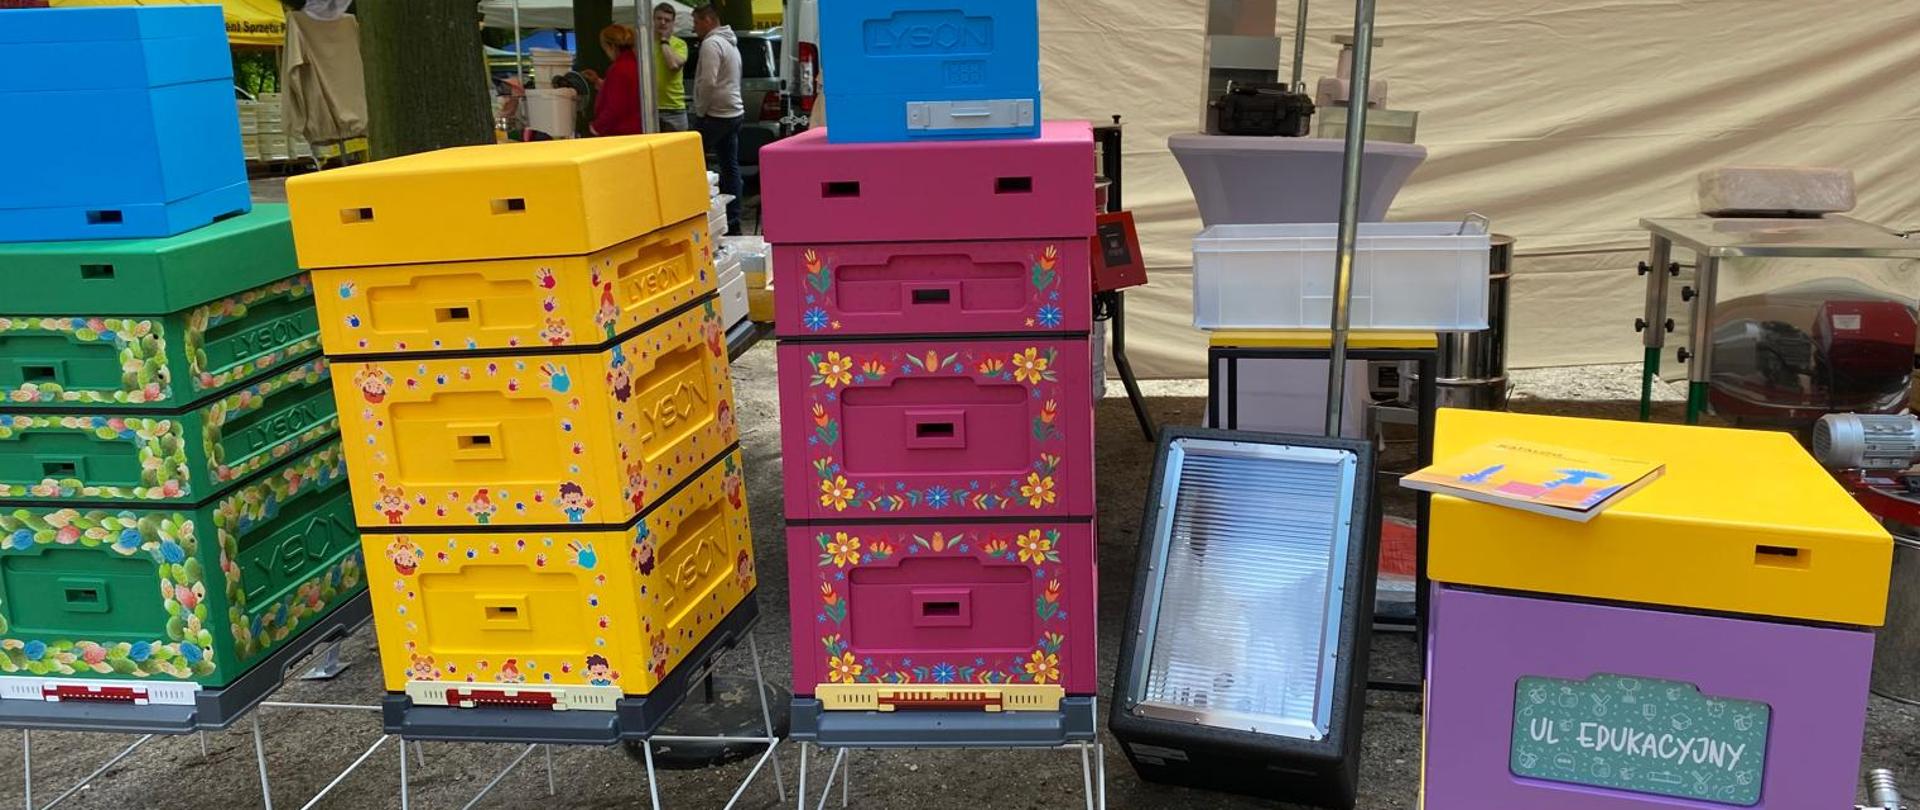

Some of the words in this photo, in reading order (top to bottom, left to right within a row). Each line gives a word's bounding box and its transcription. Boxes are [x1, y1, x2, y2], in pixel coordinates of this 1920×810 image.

[872, 23, 988, 49] LYSON
[627, 263, 682, 304] LYSON
[231, 314, 304, 357] LYSON
[247, 400, 318, 450] LYSON
[637, 373, 707, 444] LYSON
[240, 502, 357, 602] LYSON
[660, 526, 728, 612] LYSON
[1530, 717, 1559, 744] UL
[1576, 722, 1745, 771] EDUKACYJNY
